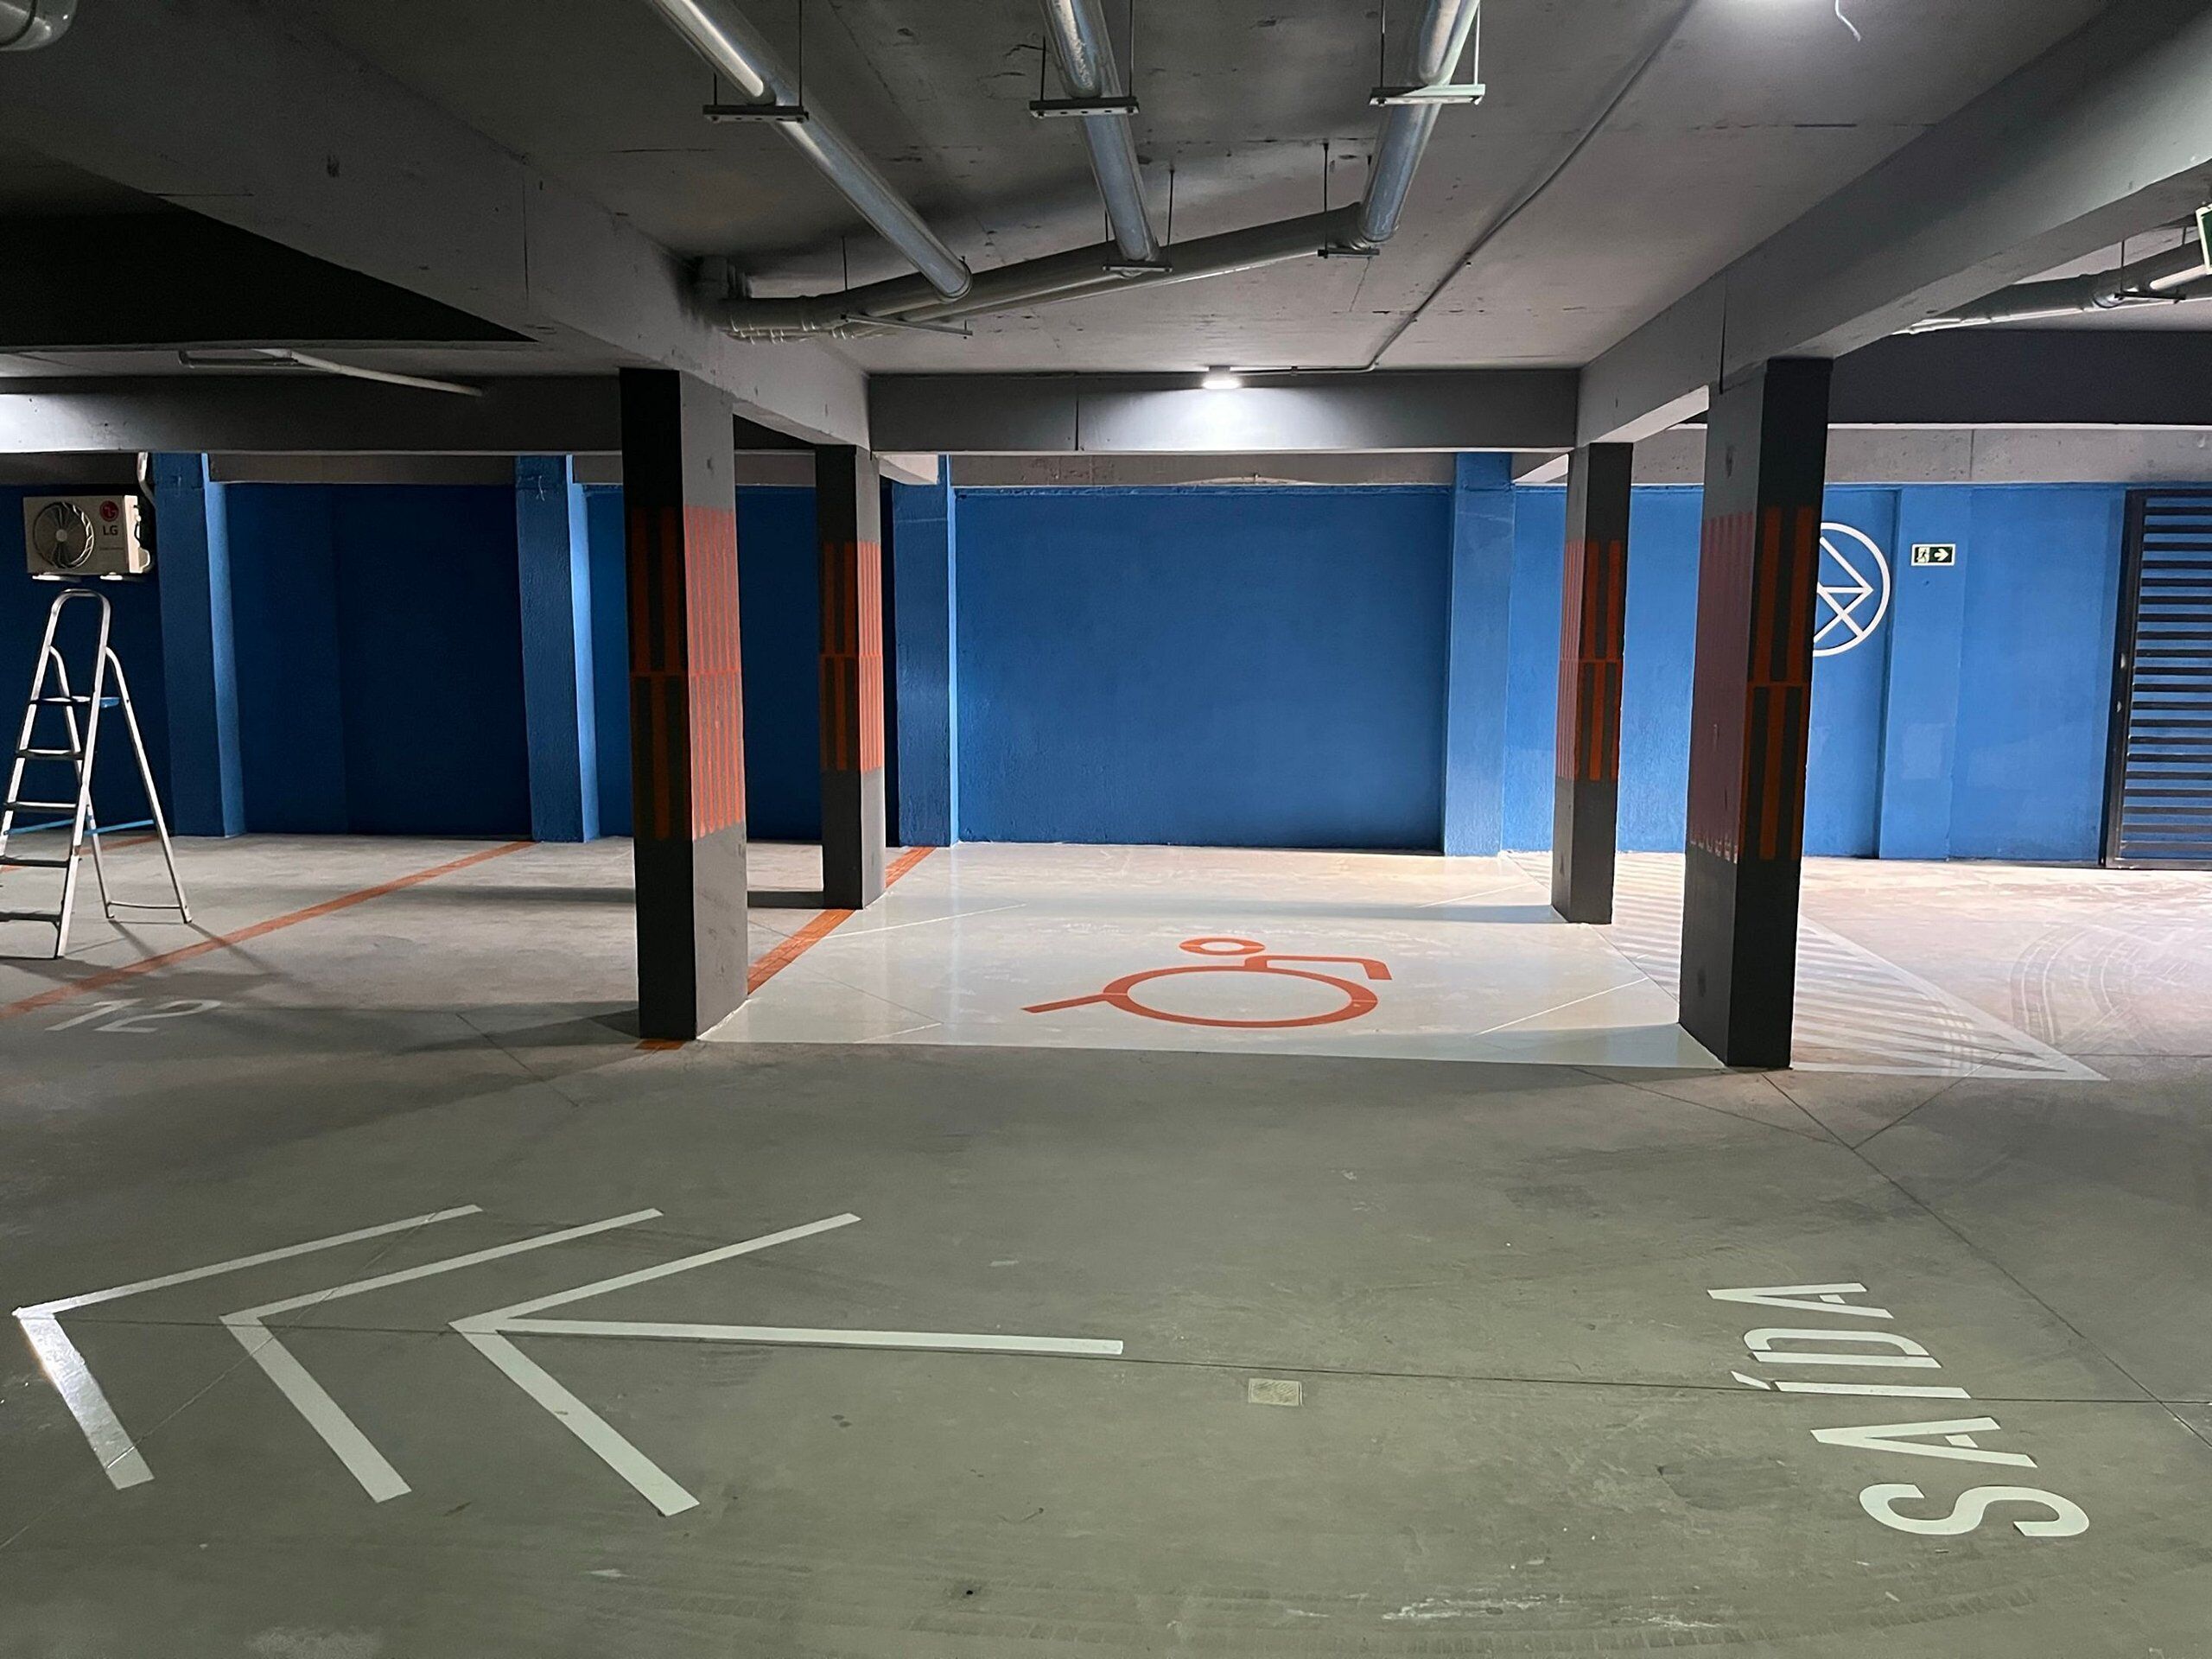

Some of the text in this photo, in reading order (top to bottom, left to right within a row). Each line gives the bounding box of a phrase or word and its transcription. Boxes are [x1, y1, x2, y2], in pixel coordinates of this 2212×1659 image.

[103, 524, 118, 536] LG
[45, 998, 222, 1033] 12
[1707, 1282, 2090, 1537] SAÍDA
